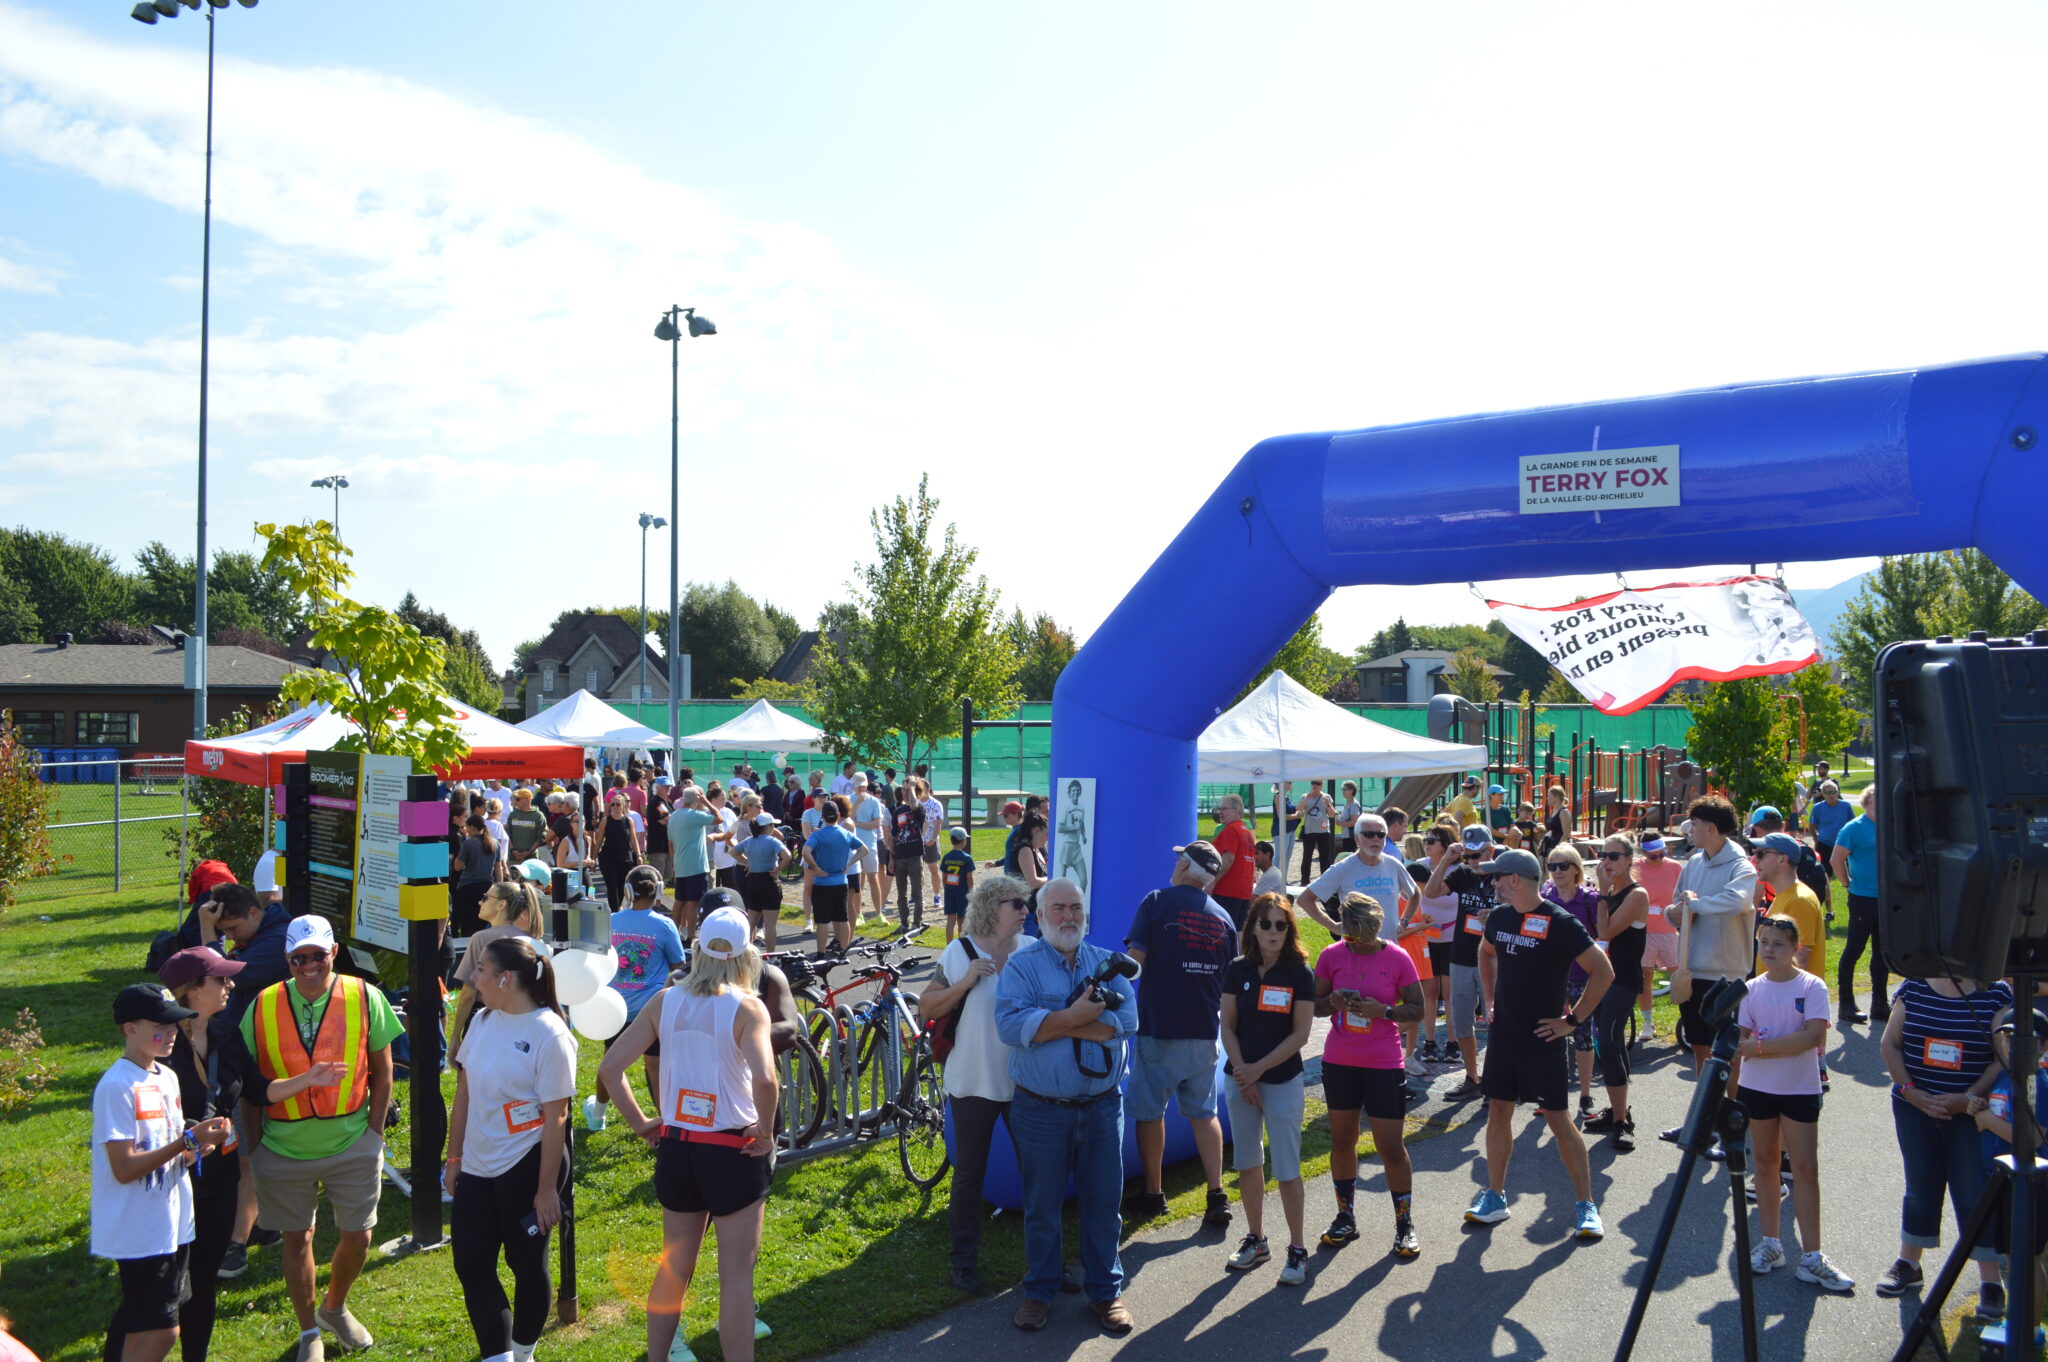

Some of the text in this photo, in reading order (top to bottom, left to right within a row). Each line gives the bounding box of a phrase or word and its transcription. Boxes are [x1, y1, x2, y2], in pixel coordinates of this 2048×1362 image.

[1526, 455, 1658, 472] LA GRANDE FIN DE SEMAINE
[1526, 467, 1669, 493] TERRY FOX
[1526, 497, 1538, 505] DE
[1539, 496, 1550, 504] LA
[202, 749, 224, 766] metro
[1354, 876, 1394, 888] adidas
